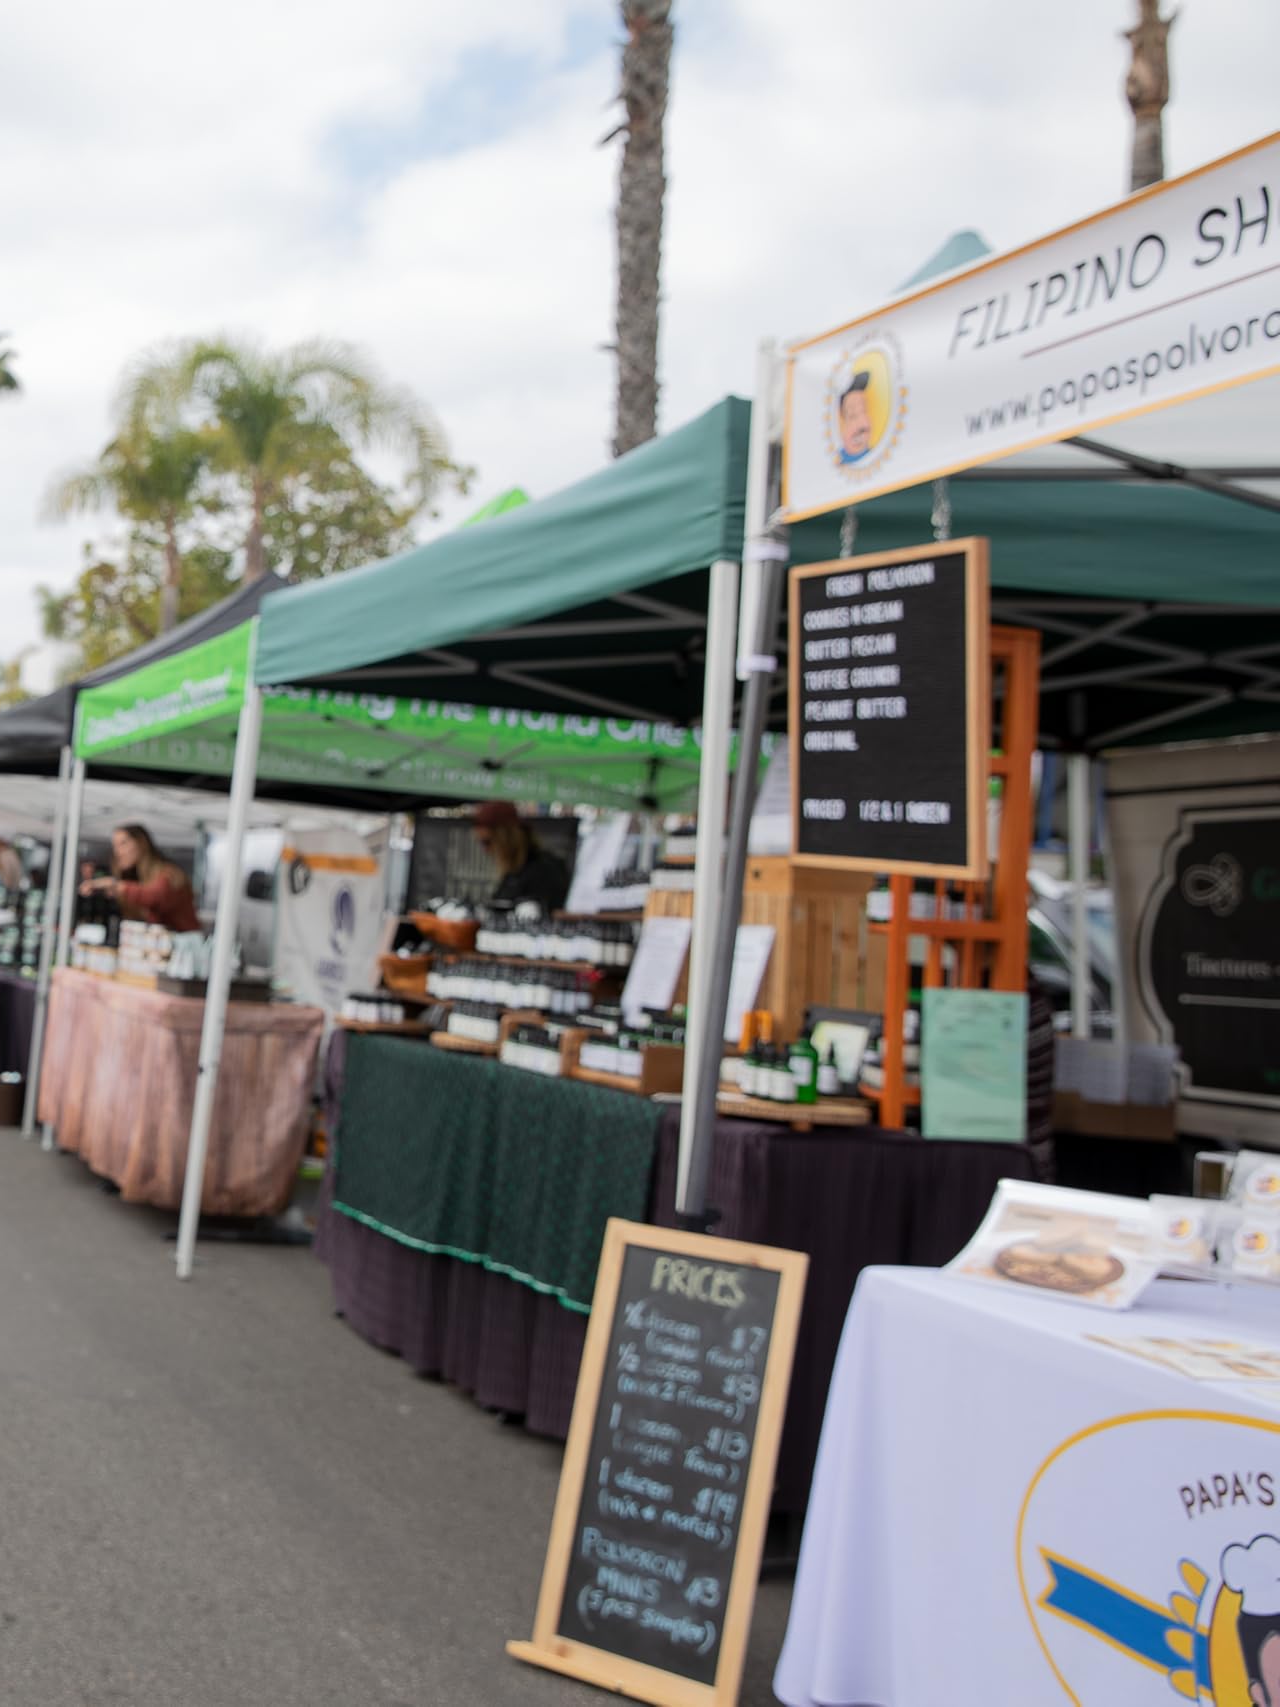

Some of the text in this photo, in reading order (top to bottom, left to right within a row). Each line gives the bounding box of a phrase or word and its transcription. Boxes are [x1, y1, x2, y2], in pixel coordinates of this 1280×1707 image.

[948, 234, 1166, 358] FILIPINO
[804, 633, 897, 662] BUTTER PECAN
[804, 664, 901, 691] TOFFEE CRUNCH
[804, 696, 907, 721] PEANUT BUTTER
[650, 1256, 747, 1309] PRICES
[1178, 1471, 1275, 1520] PAPA'S
